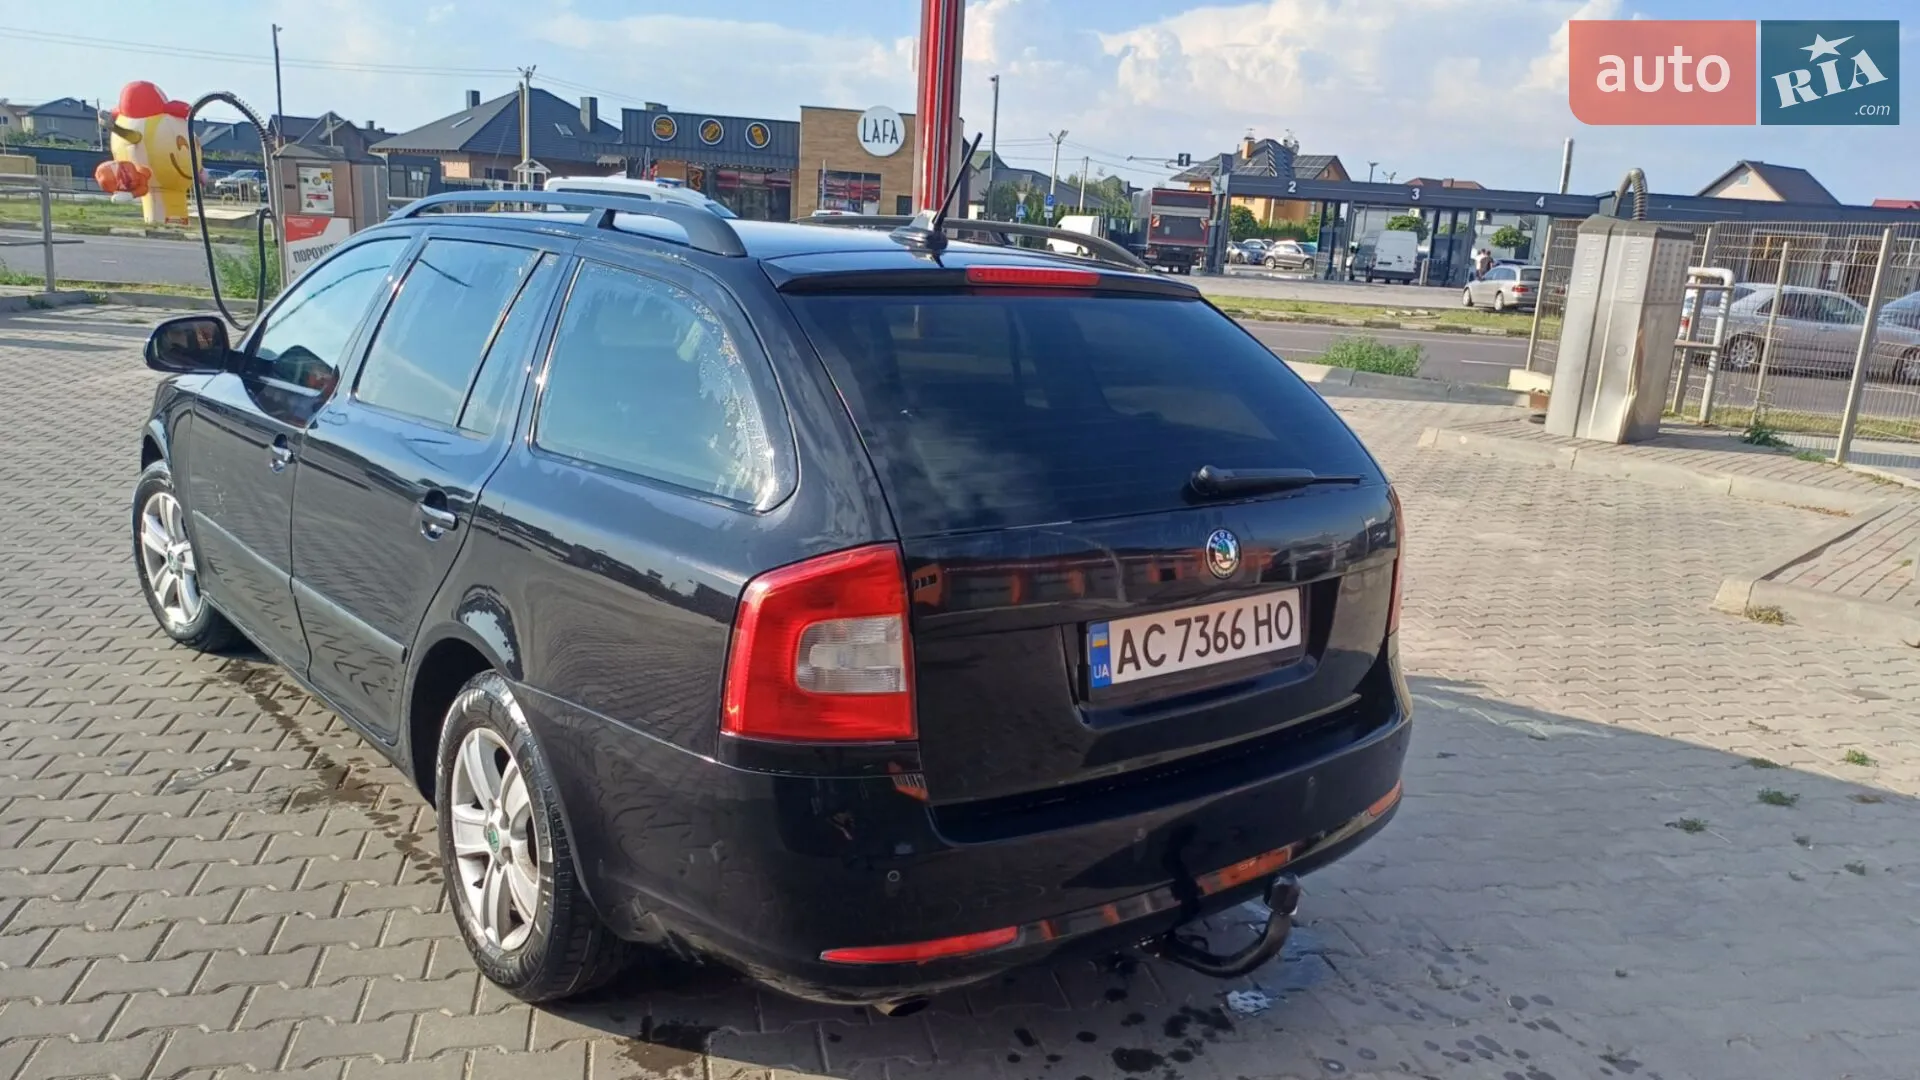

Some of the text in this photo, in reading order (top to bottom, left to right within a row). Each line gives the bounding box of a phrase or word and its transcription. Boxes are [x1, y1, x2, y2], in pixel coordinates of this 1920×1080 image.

[863, 117, 899, 145] LAFA
[1180, 154, 1188, 166] 1
[1287, 180, 1297, 193] 2
[1411, 188, 1420, 200] 3
[1535, 196, 1545, 208] 4
[1117, 600, 1294, 674] AC 7366 HO
[1093, 663, 1109, 679] UA
